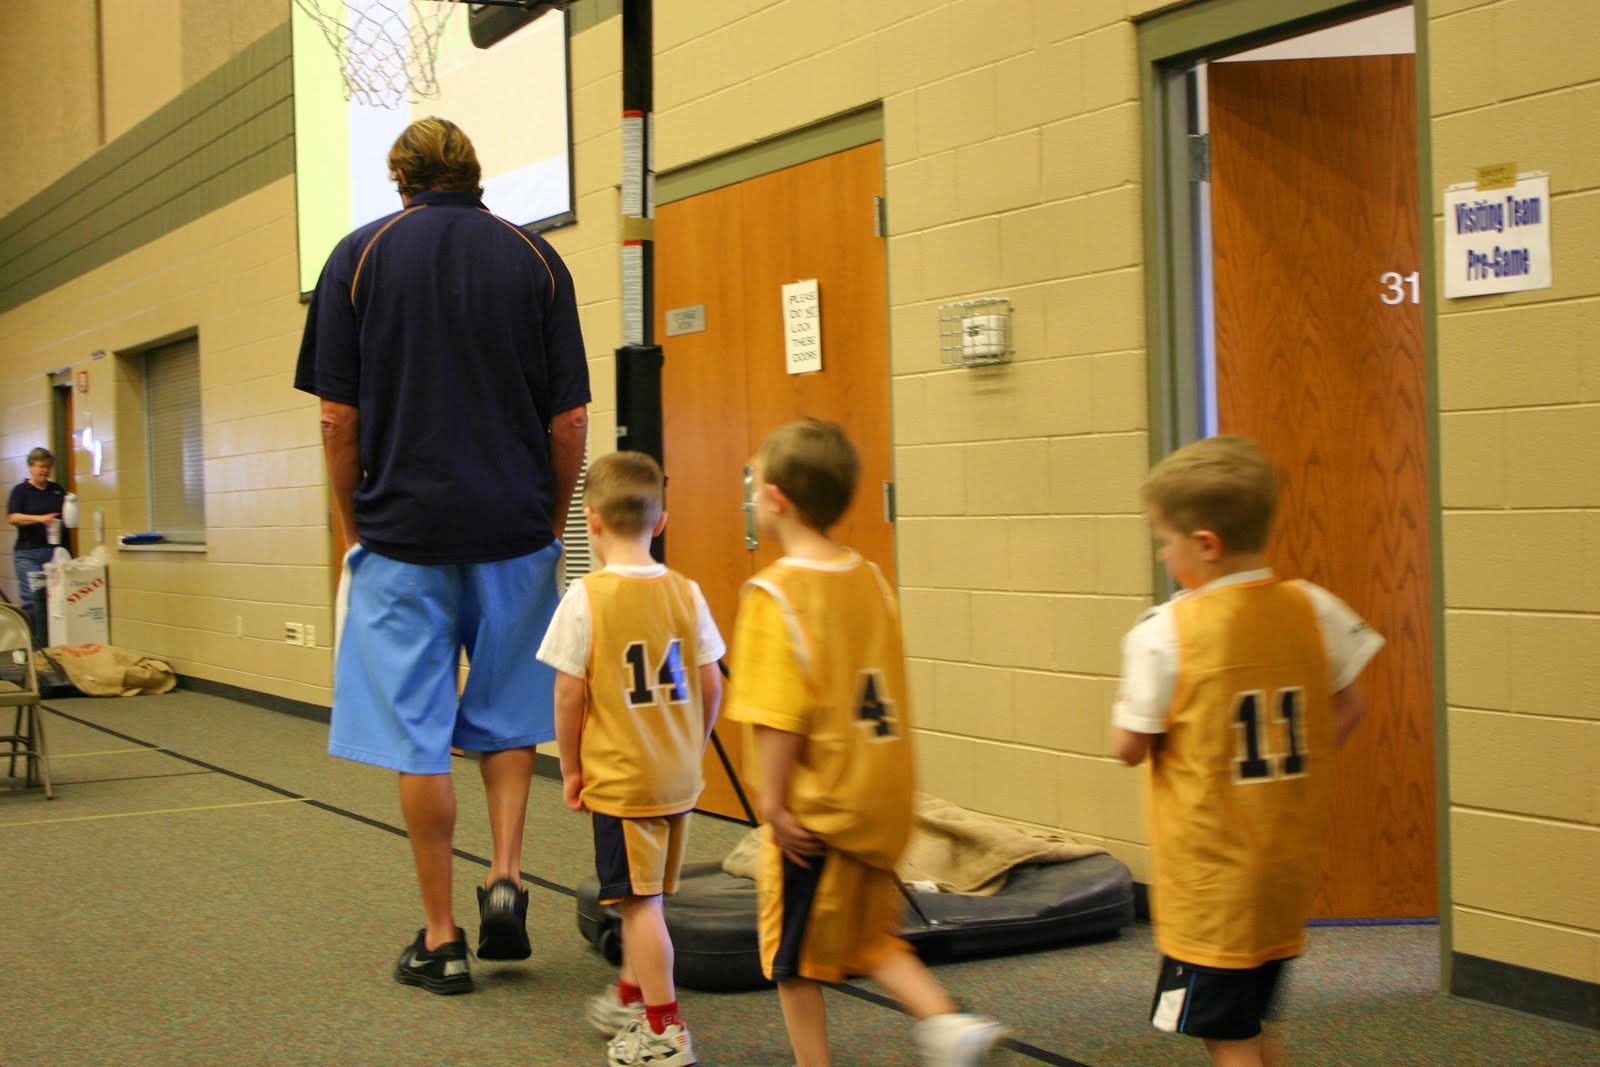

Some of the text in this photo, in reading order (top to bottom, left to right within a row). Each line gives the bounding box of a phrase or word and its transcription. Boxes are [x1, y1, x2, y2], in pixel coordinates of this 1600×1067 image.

[1455, 195, 1541, 235] Visiting Team
[1467, 246, 1529, 281] Pre-Game
[788, 290, 817, 305] PLEASE
[1380, 271, 1420, 305] 31
[790, 305, 818, 319] DO NOT
[792, 335, 816, 348] THESE
[792, 350, 817, 363] DOORS
[622, 637, 690, 708] 14
[851, 667, 901, 744] 4
[1229, 686, 1311, 786] 11
